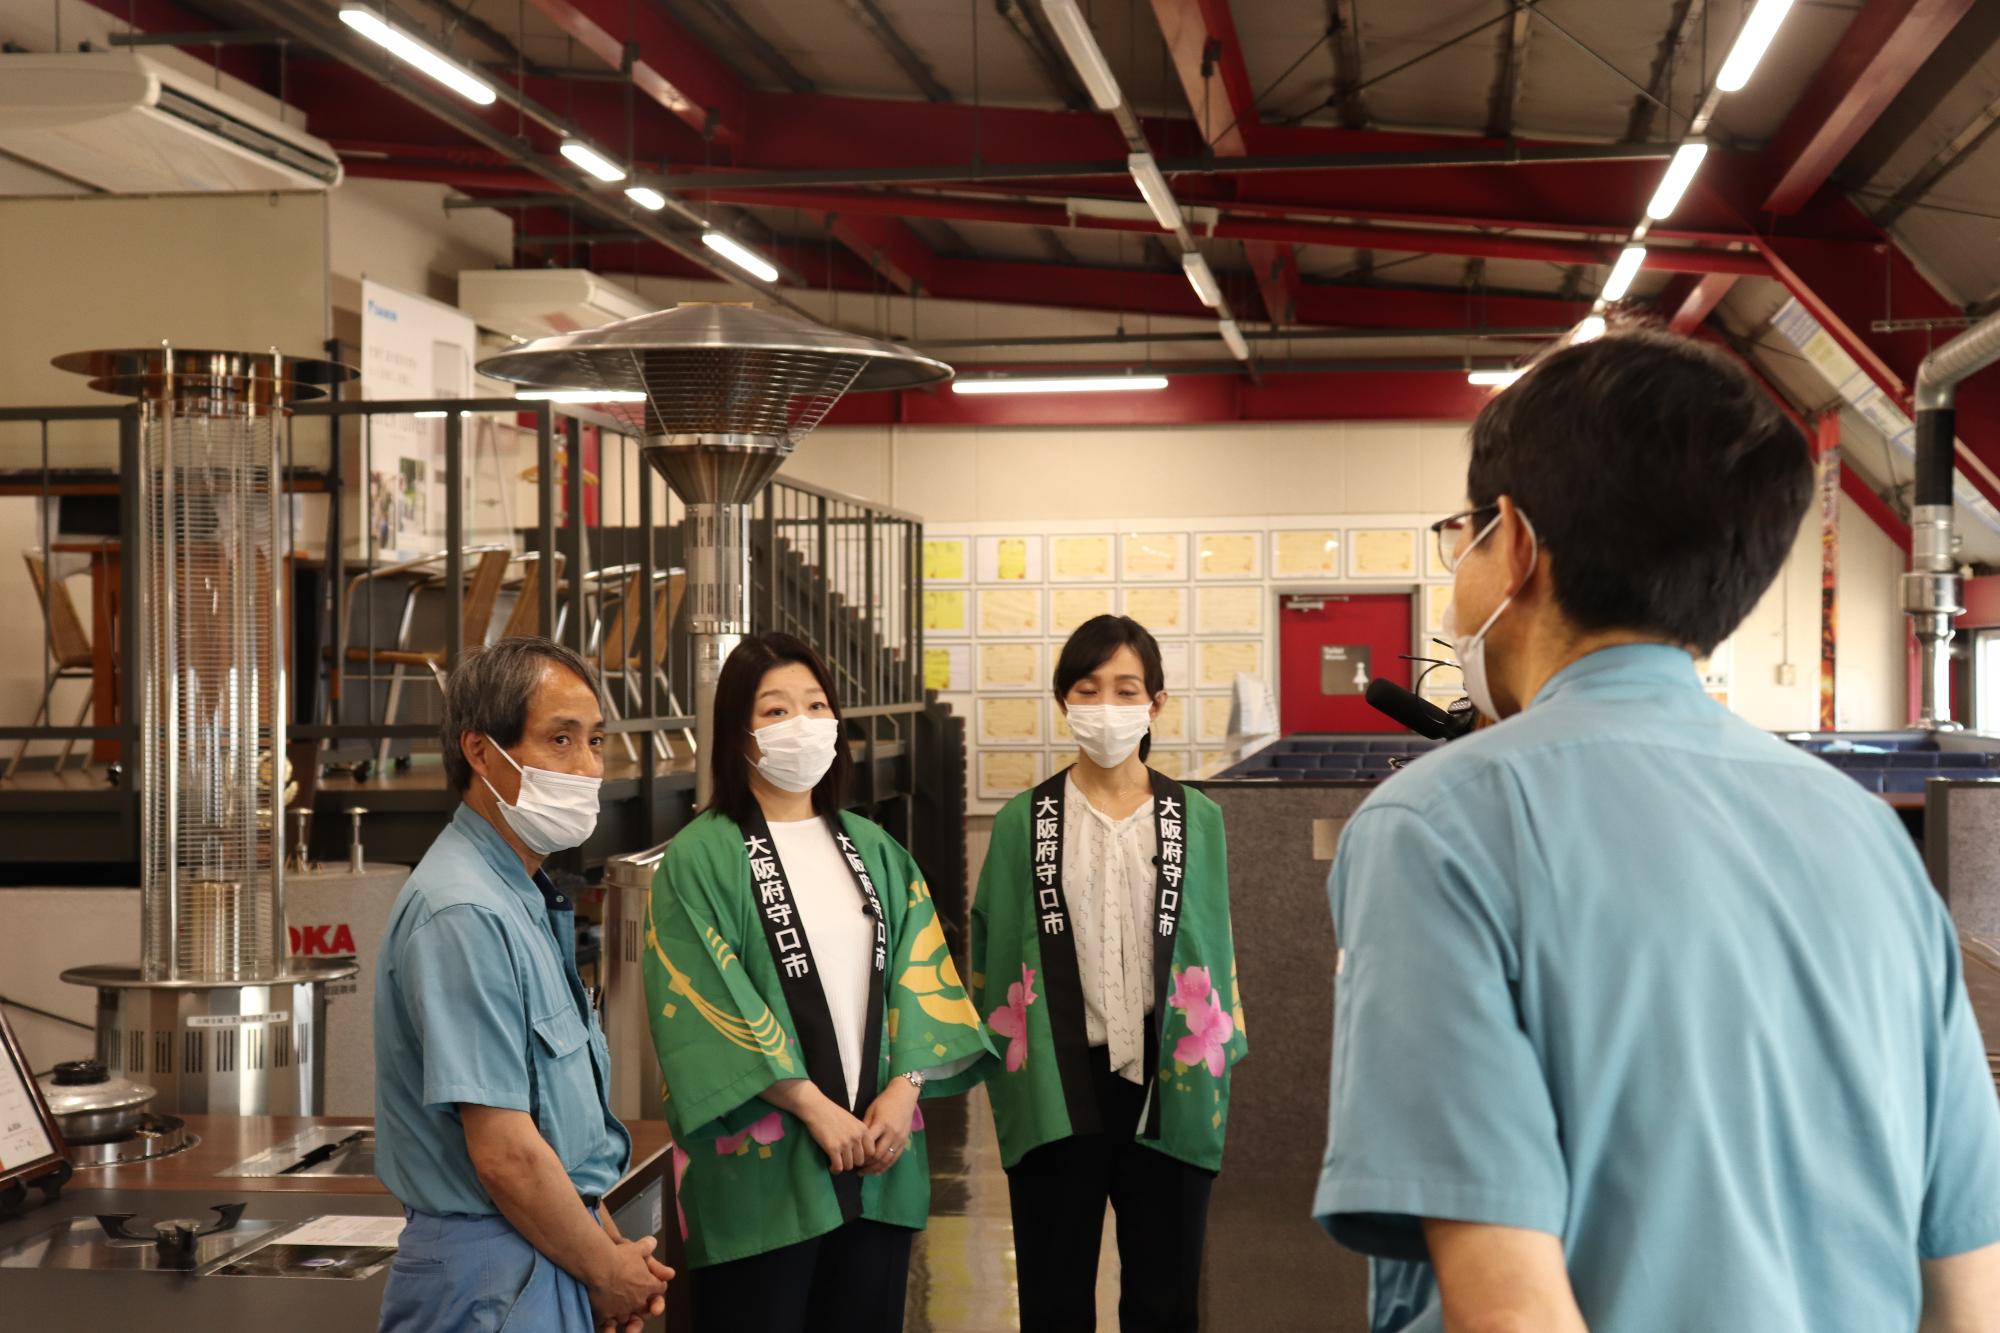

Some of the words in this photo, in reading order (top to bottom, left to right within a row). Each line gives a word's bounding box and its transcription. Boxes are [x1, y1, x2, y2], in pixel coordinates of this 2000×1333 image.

[744, 835, 809, 978] 大阪府守口市
[1035, 796, 1064, 935] 大阪府守口市
[1159, 796, 1184, 937] 大阪府守口市
